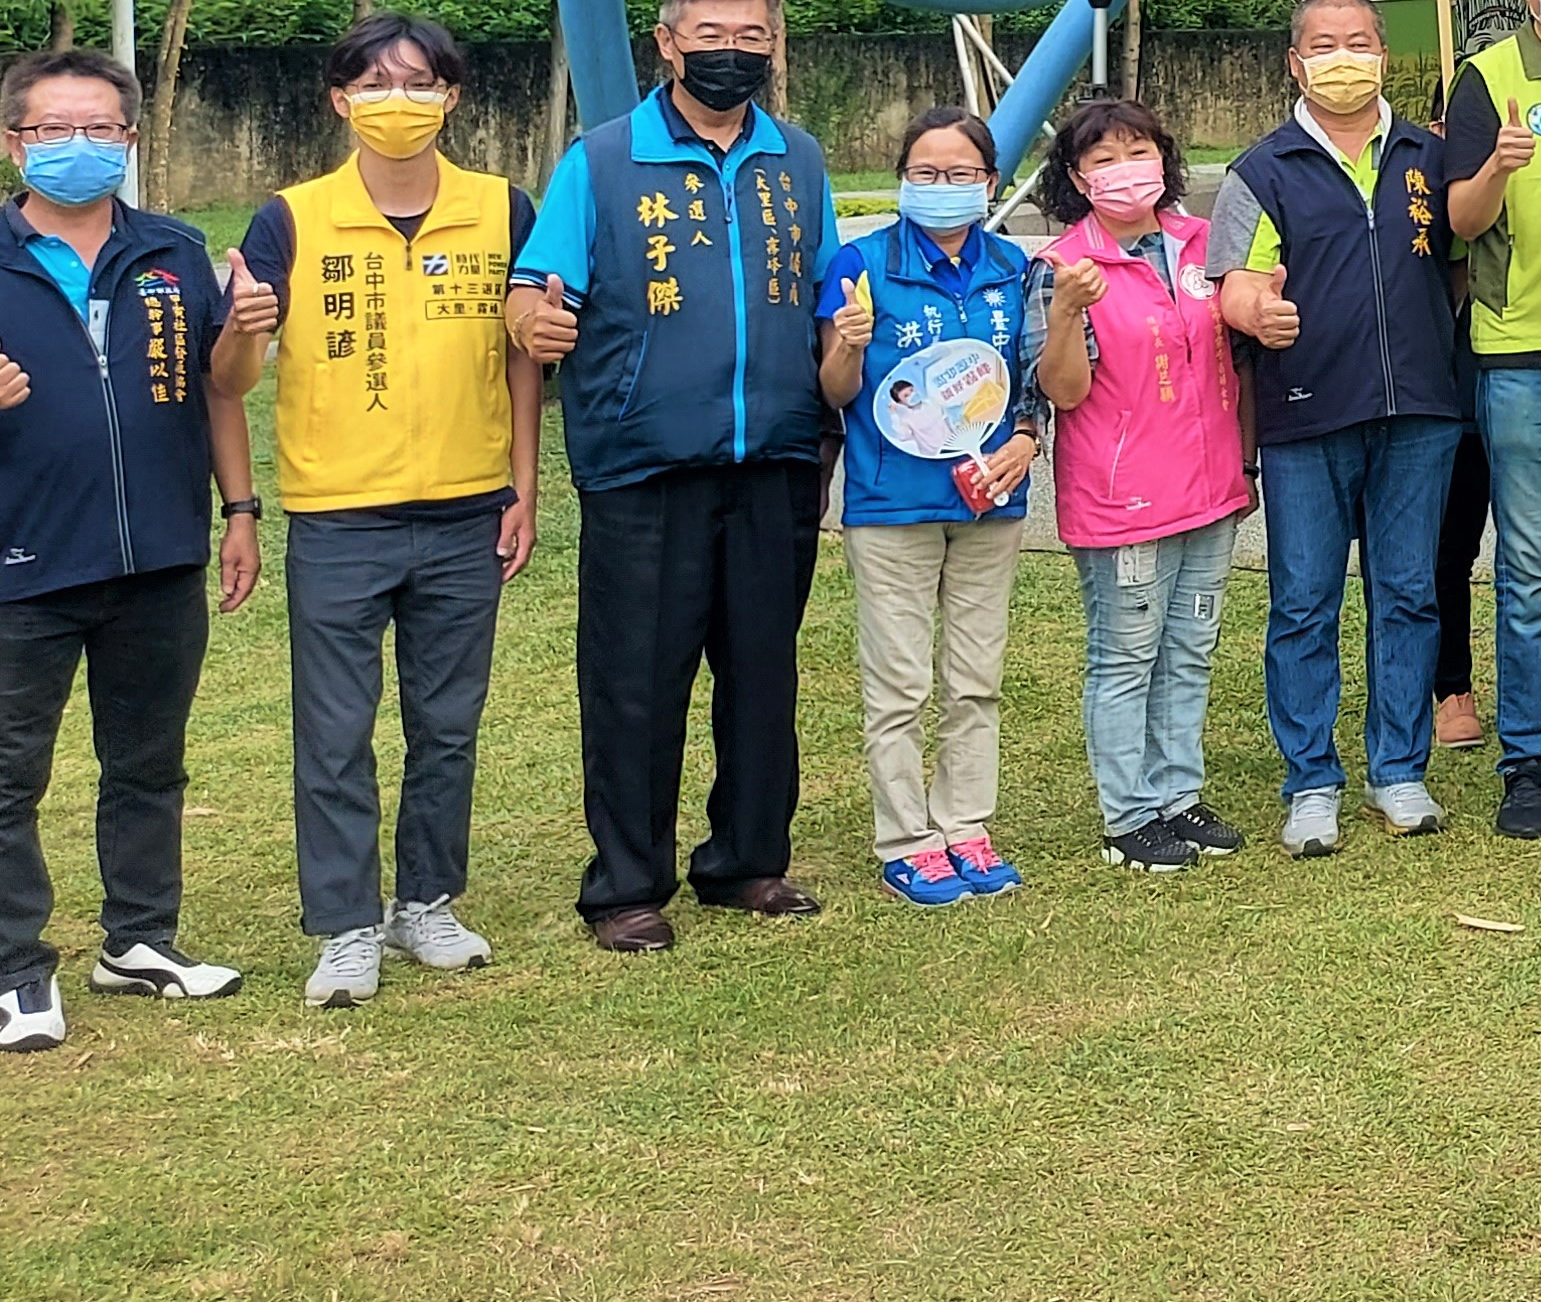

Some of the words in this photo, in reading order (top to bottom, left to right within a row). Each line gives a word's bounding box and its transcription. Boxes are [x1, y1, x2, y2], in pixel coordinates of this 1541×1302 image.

[636, 190, 684, 317] 林子傑
[683, 172, 714, 248] 參選人
[363, 251, 389, 413] 台中市議員參選人
